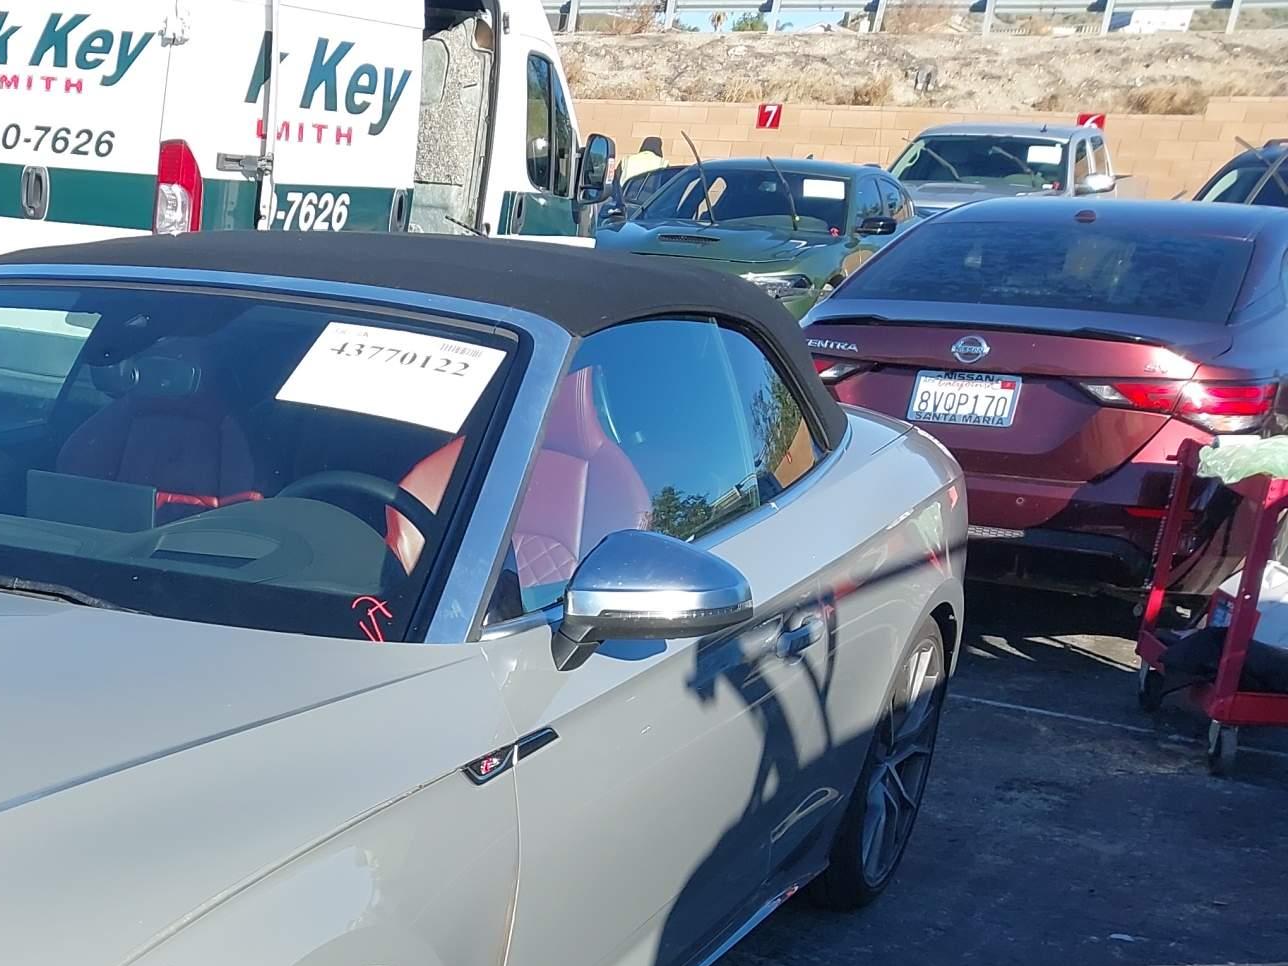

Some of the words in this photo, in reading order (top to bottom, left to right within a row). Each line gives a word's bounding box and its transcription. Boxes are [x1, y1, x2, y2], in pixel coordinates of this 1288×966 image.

[28, 12, 156, 87] Key
[299, 36, 413, 136] Key
[765, 105, 778, 128] 7
[806, 338, 859, 353] ENTRA
[330, 341, 470, 377] 43770122
[943, 371, 995, 382] NISSAN
[917, 390, 1008, 417] 8VQP170
[915, 411, 956, 422] SANTA
[962, 414, 1004, 425] MARIA
